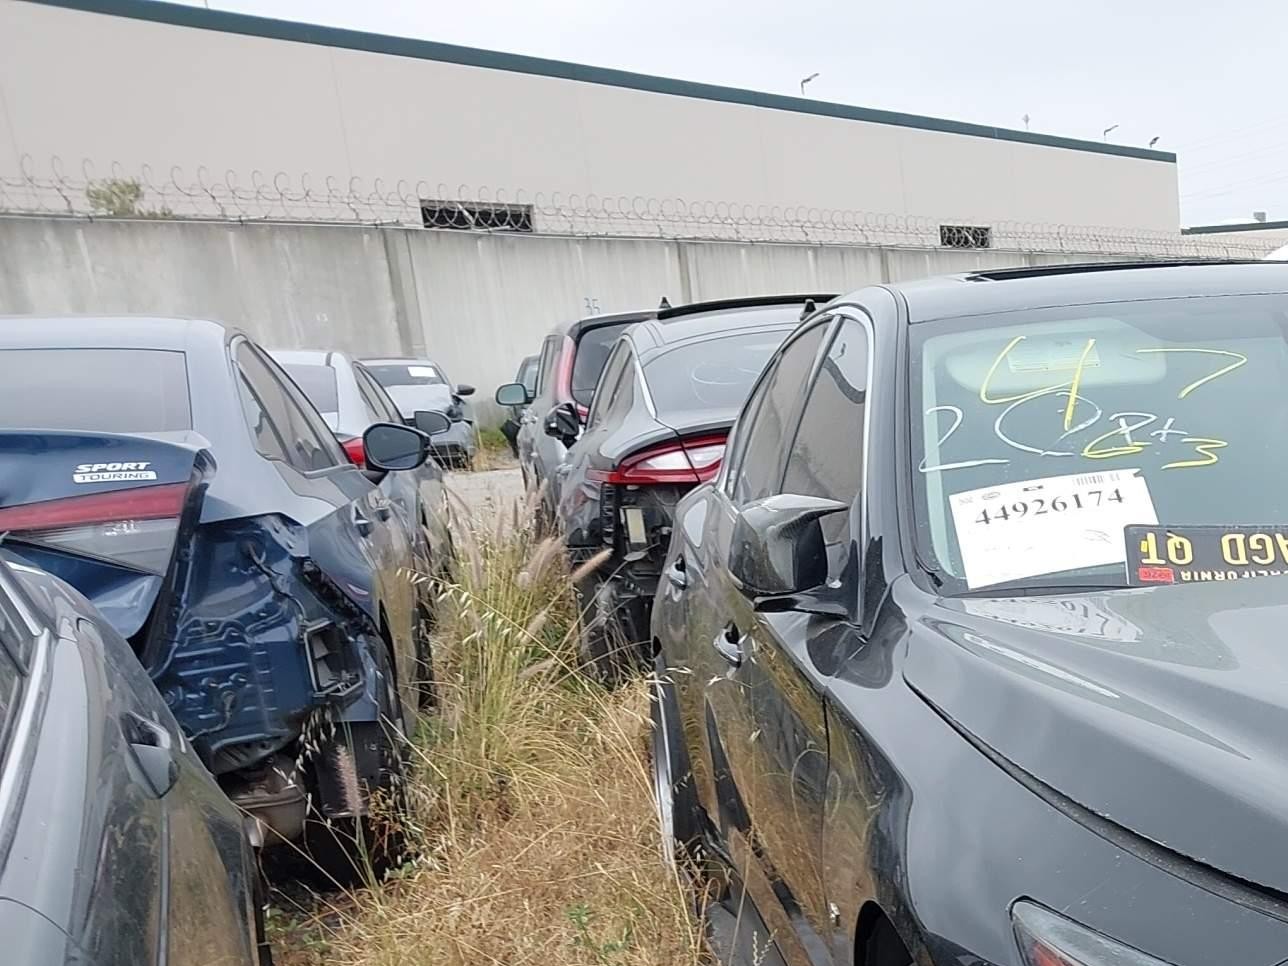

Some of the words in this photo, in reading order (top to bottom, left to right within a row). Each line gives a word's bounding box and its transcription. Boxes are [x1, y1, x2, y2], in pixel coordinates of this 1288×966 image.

[74, 461, 151, 473] SPORT
[79, 472, 152, 482] TOURING
[975, 488, 1125, 525] 44926174
[1141, 531, 1193, 565] QT
